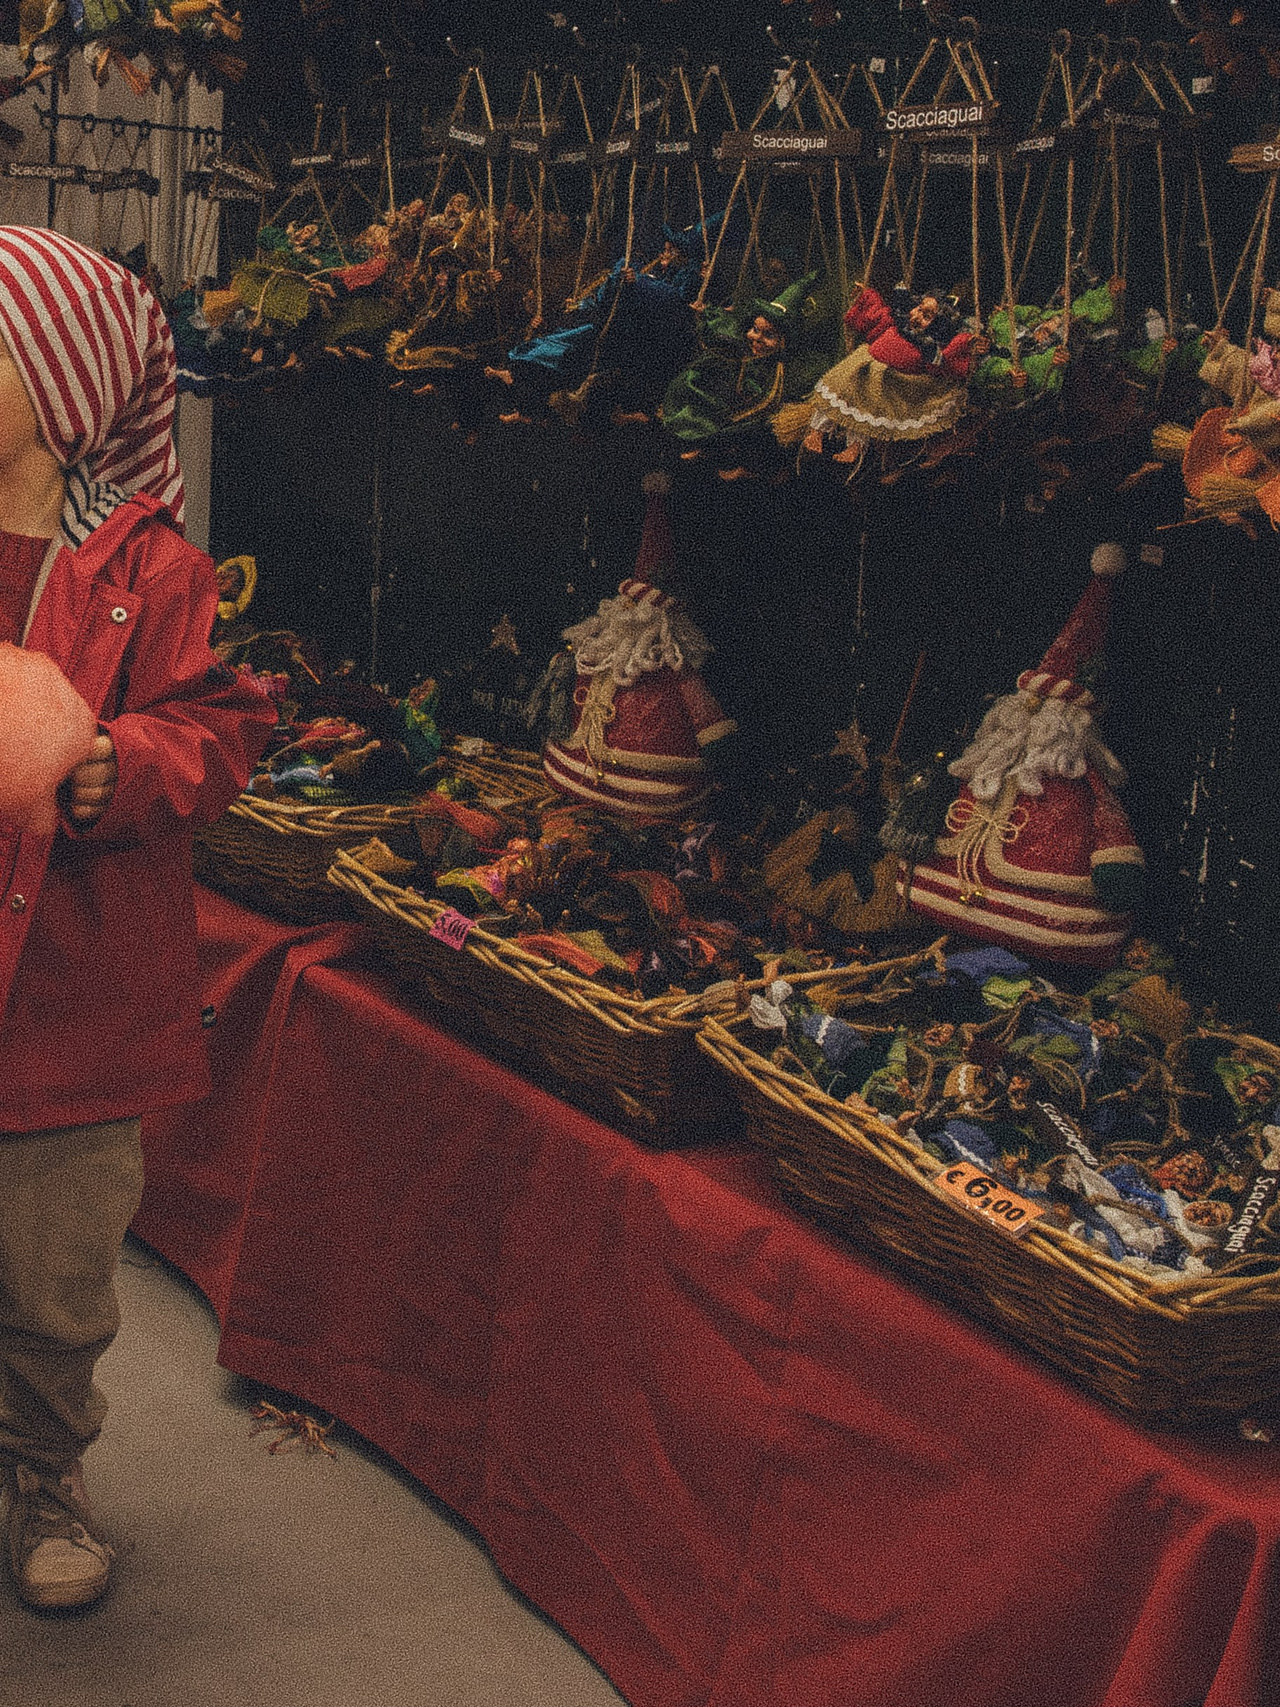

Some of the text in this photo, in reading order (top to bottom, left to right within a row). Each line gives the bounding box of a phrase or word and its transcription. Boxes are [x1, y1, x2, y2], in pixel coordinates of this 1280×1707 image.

[886, 101, 983, 130] Scacciaguai
[753, 134, 827, 152] Scacciaguai
[921, 150, 989, 167] Scacciagai
[964, 1177, 1026, 1222] 6,00
[1224, 1176, 1277, 1253] Scacciaguai
